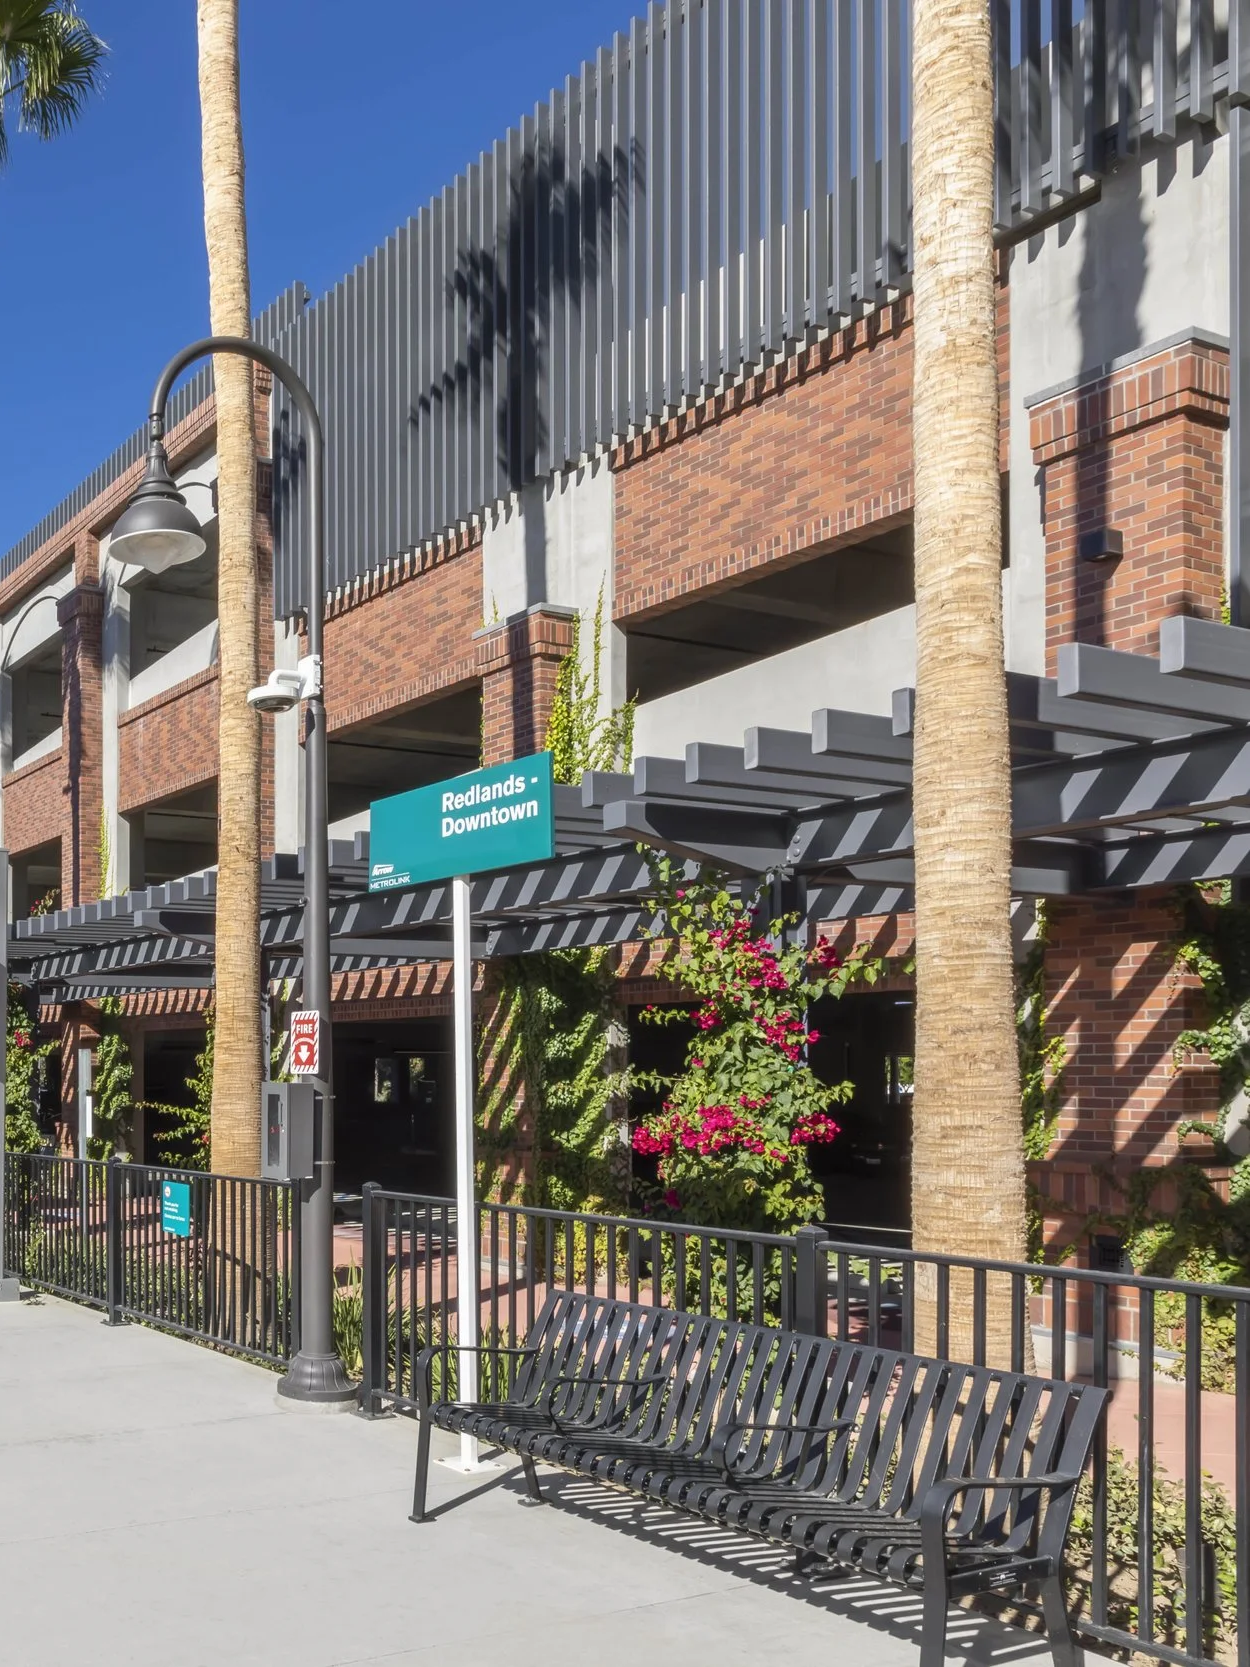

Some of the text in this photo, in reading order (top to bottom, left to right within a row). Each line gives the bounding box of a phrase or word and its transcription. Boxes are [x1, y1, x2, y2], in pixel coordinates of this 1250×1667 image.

[442, 774, 526, 813] Redlands
[442, 799, 538, 838] Downtown
[370, 875, 410, 889] METROLINK
[296, 1023, 313, 1033] FIRE
